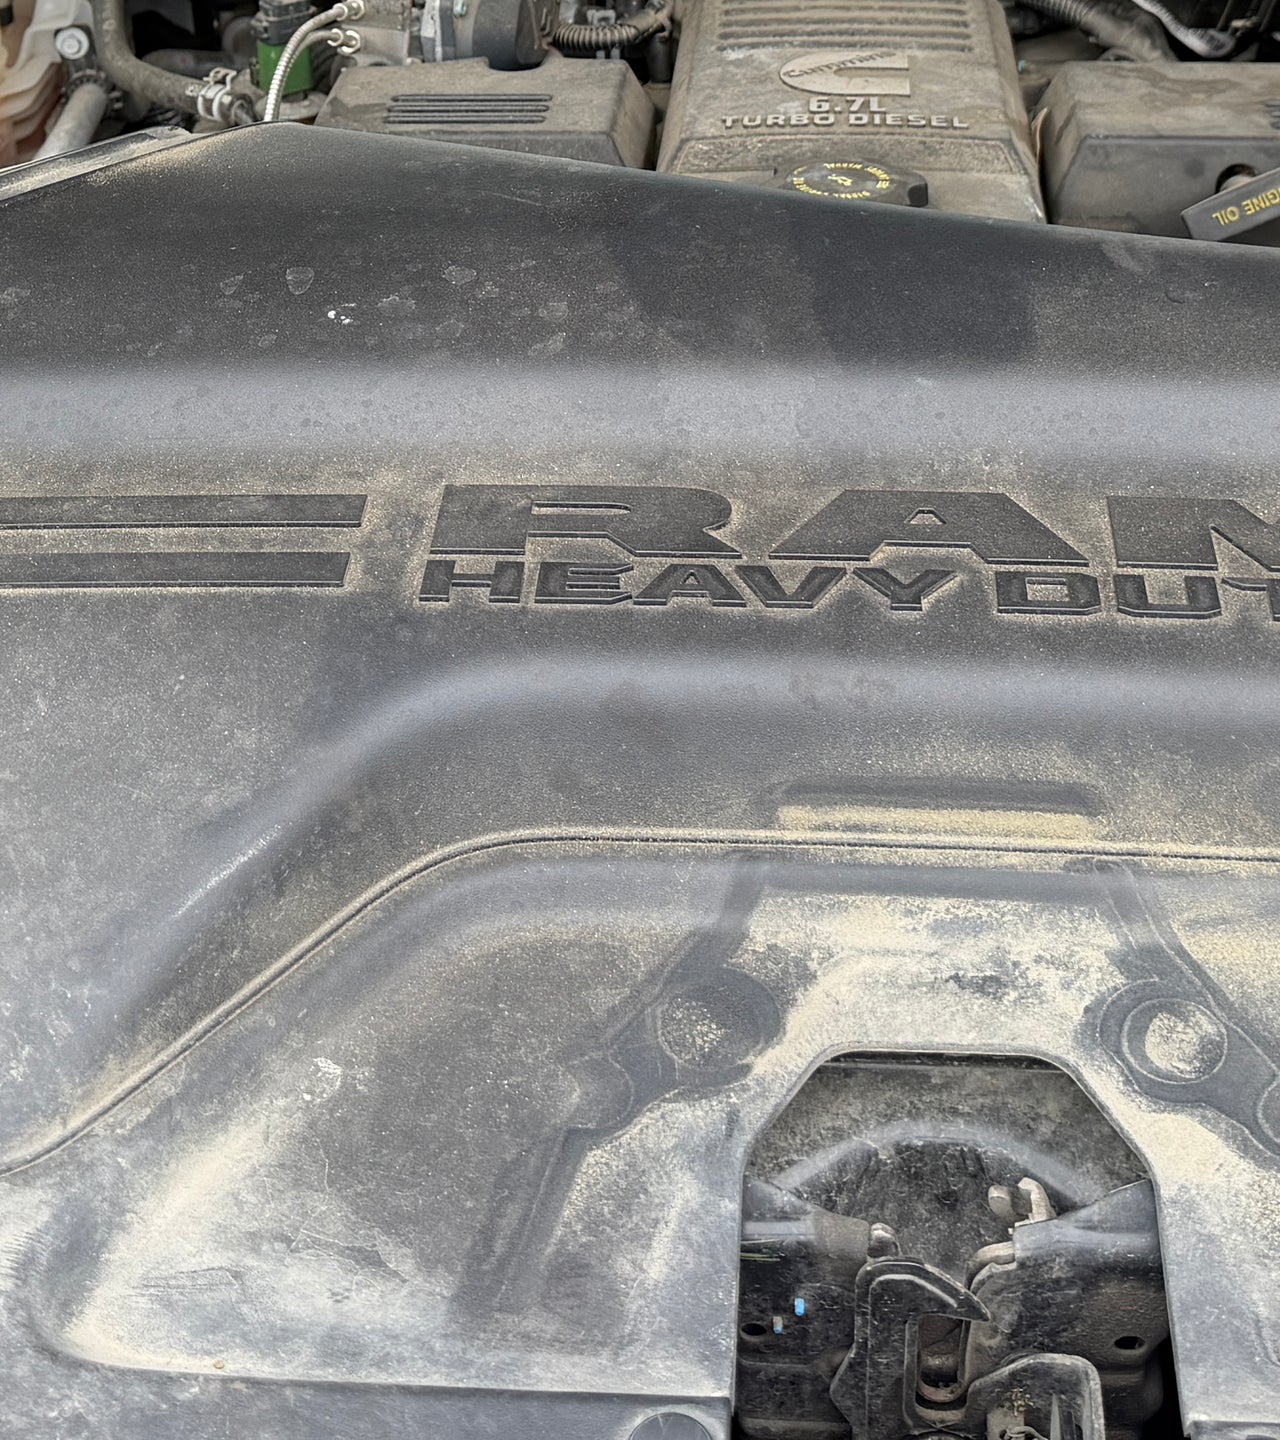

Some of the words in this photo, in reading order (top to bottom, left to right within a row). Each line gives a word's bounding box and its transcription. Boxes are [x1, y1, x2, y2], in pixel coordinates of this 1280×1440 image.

[808, 96, 887, 113] 6.7L
[721, 114, 835, 129] TURBO
[848, 114, 969, 129] DIESEL
[1212, 205, 1240, 227] OIL
[419, 559, 956, 610] HEAVY
